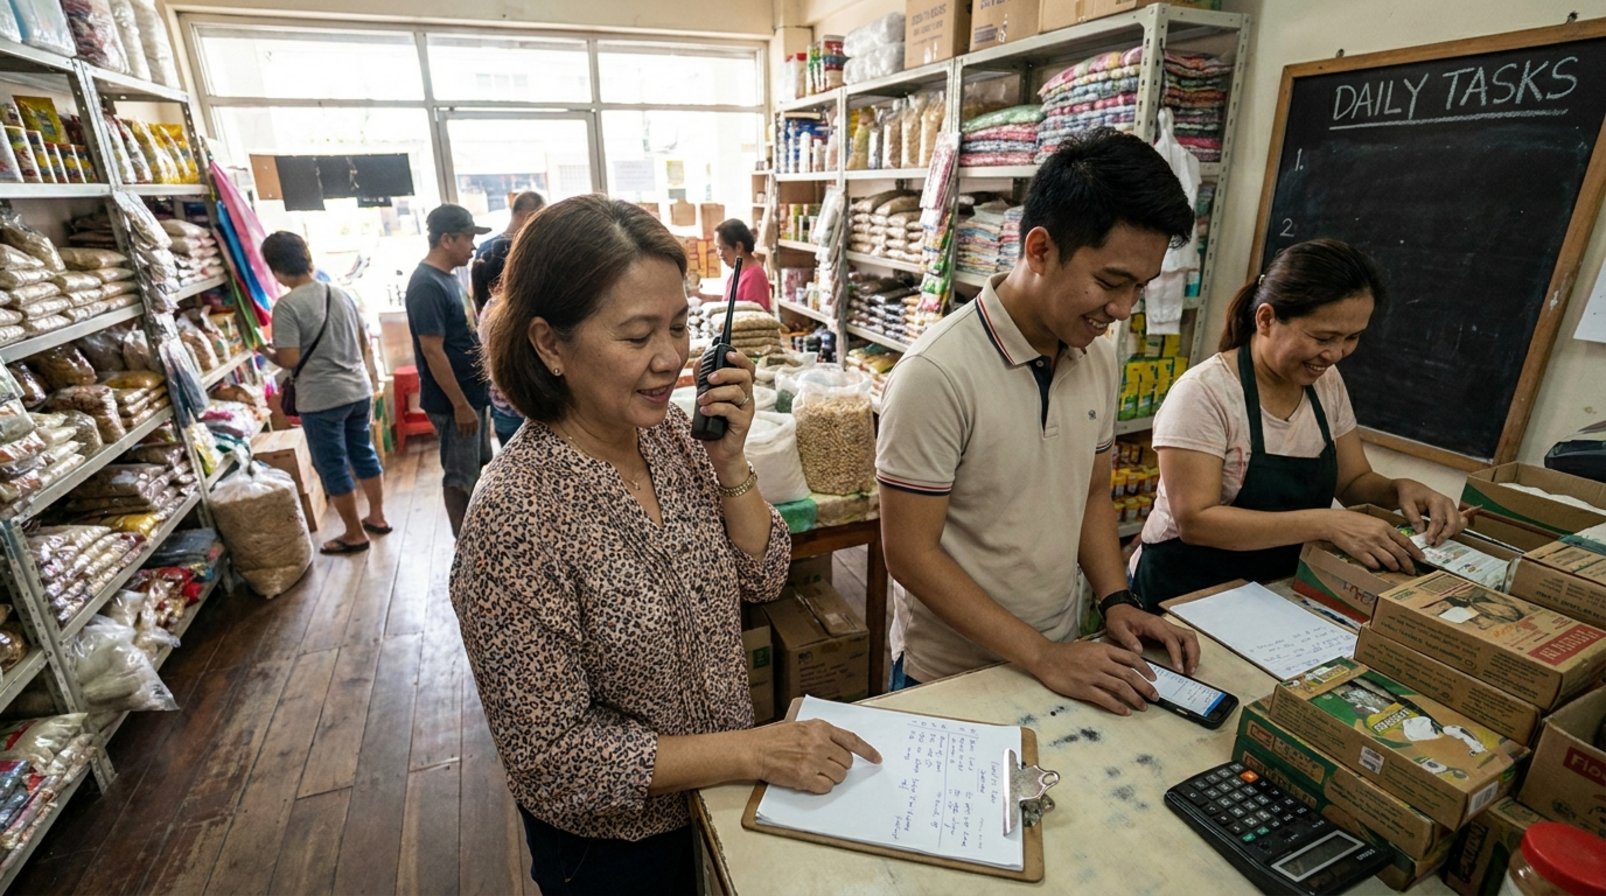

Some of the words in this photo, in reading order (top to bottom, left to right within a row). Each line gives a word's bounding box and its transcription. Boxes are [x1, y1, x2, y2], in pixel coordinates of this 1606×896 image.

[1333, 73, 1429, 120] DAILY
[1442, 56, 1578, 110] TASKS
[1294, 148, 1304, 172] 1.
[1280, 217, 1295, 237] 2
[1570, 753, 1606, 781] Flo
